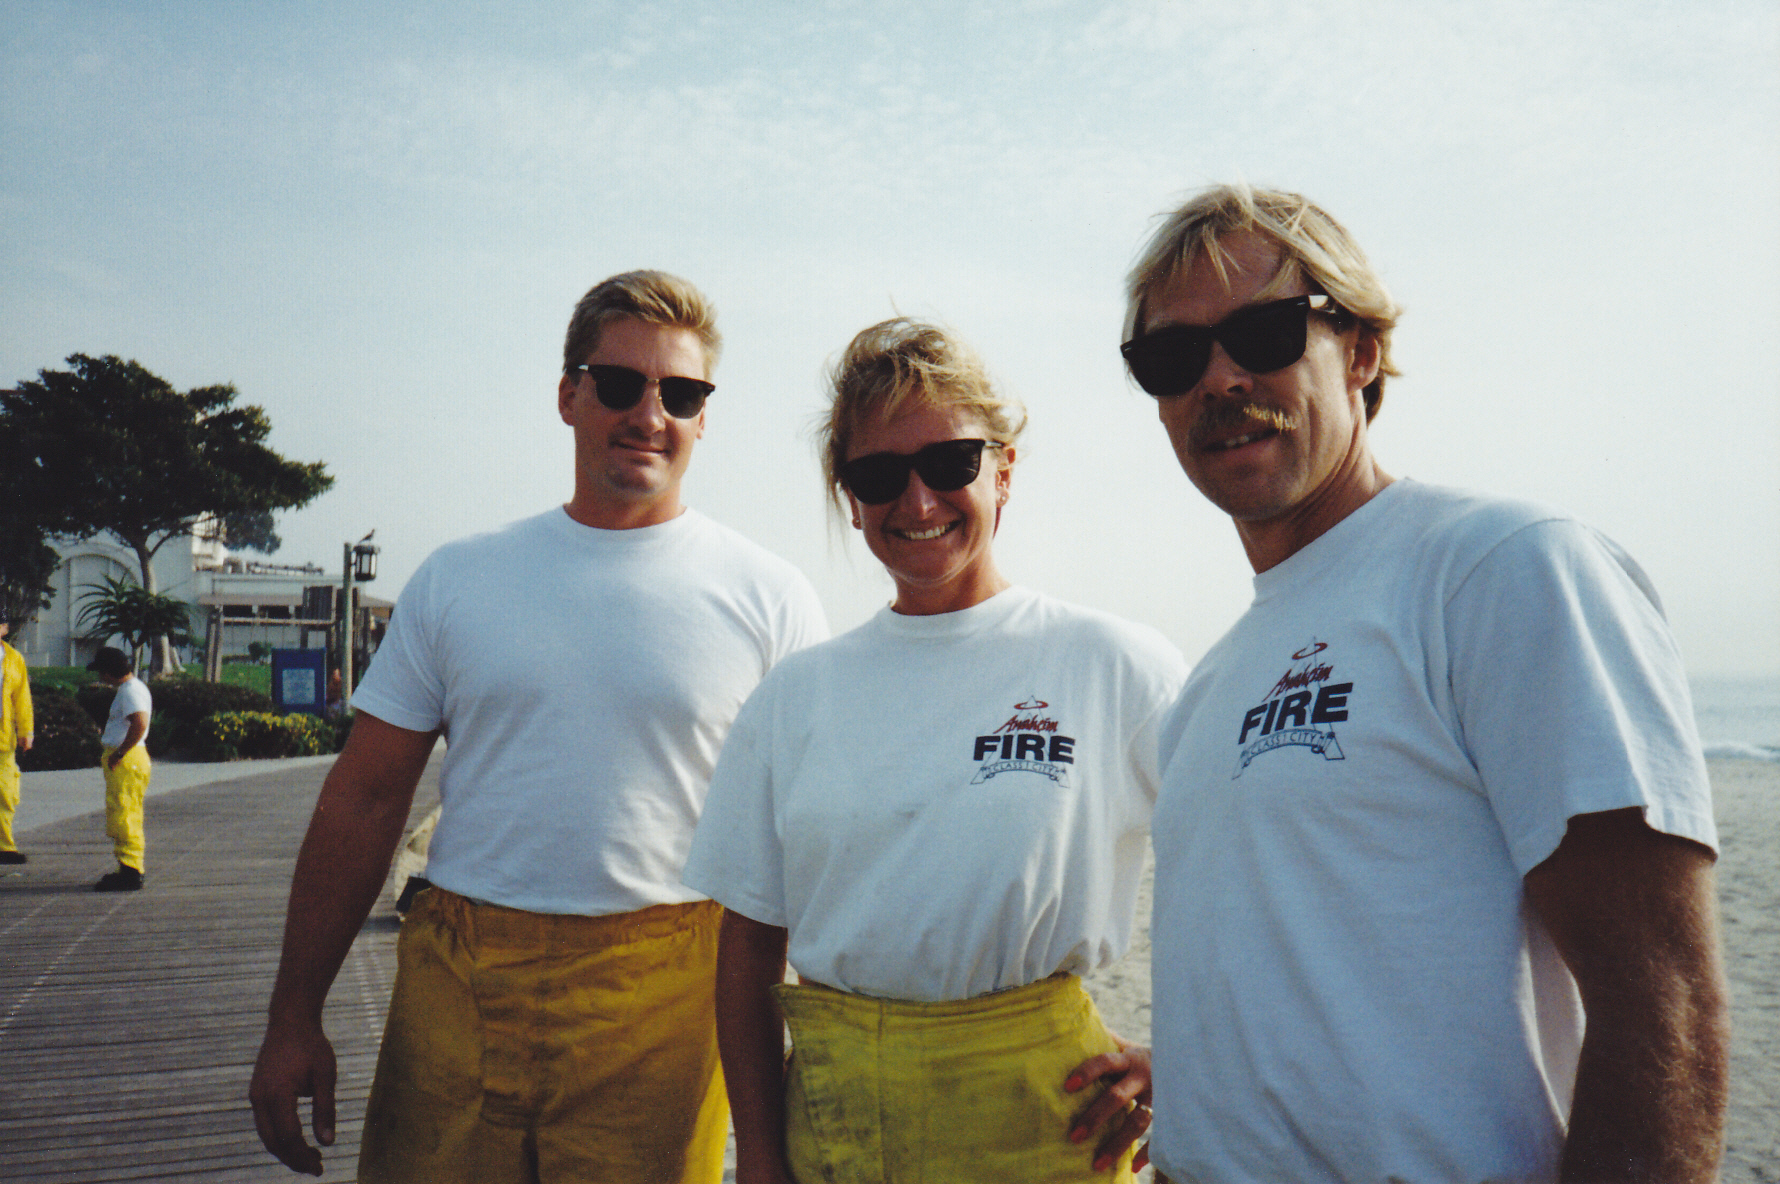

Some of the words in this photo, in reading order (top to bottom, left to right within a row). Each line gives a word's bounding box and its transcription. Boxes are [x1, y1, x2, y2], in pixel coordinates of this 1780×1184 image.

[1261, 662, 1333, 702] Anaheim
[993, 714, 1059, 735] Anaheim
[1238, 682, 1353, 745] FIRE
[973, 733, 1076, 765] FIRE
[1289, 731, 1317, 743] CITY
[993, 762, 1023, 772] CLASS
[1032, 763, 1054, 774] CITY
